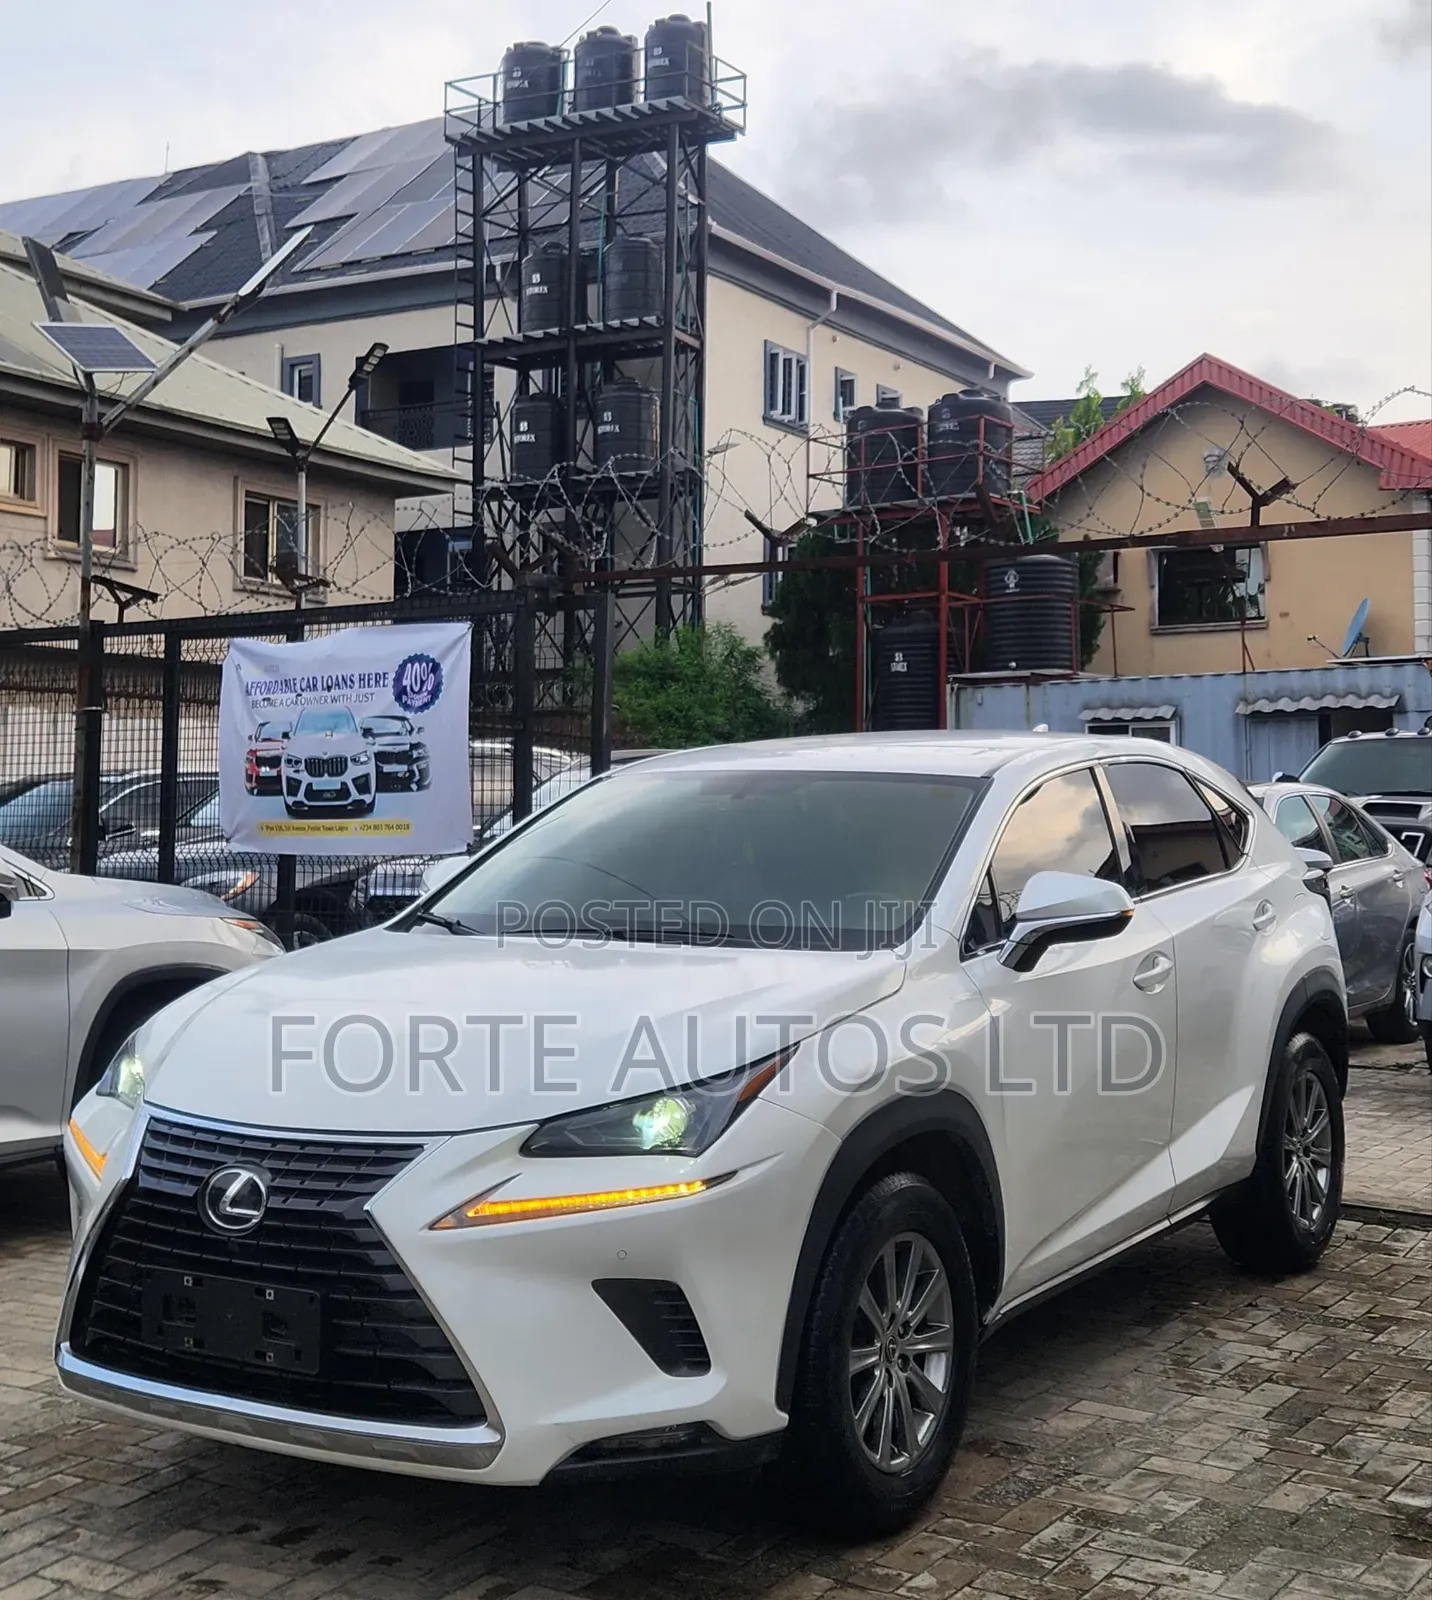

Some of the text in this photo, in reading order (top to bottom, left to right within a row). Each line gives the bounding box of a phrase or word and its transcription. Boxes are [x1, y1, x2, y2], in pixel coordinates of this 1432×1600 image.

[245, 671, 389, 697] AFFORDABLE CAR LOANS HERE
[402, 662, 435, 692] 40%
[251, 697, 279, 709] BECOME
[285, 696, 299, 707] CAR
[300, 694, 329, 707] OWNER
[330, 693, 352, 705] WITH
[353, 692, 375, 703] JUST
